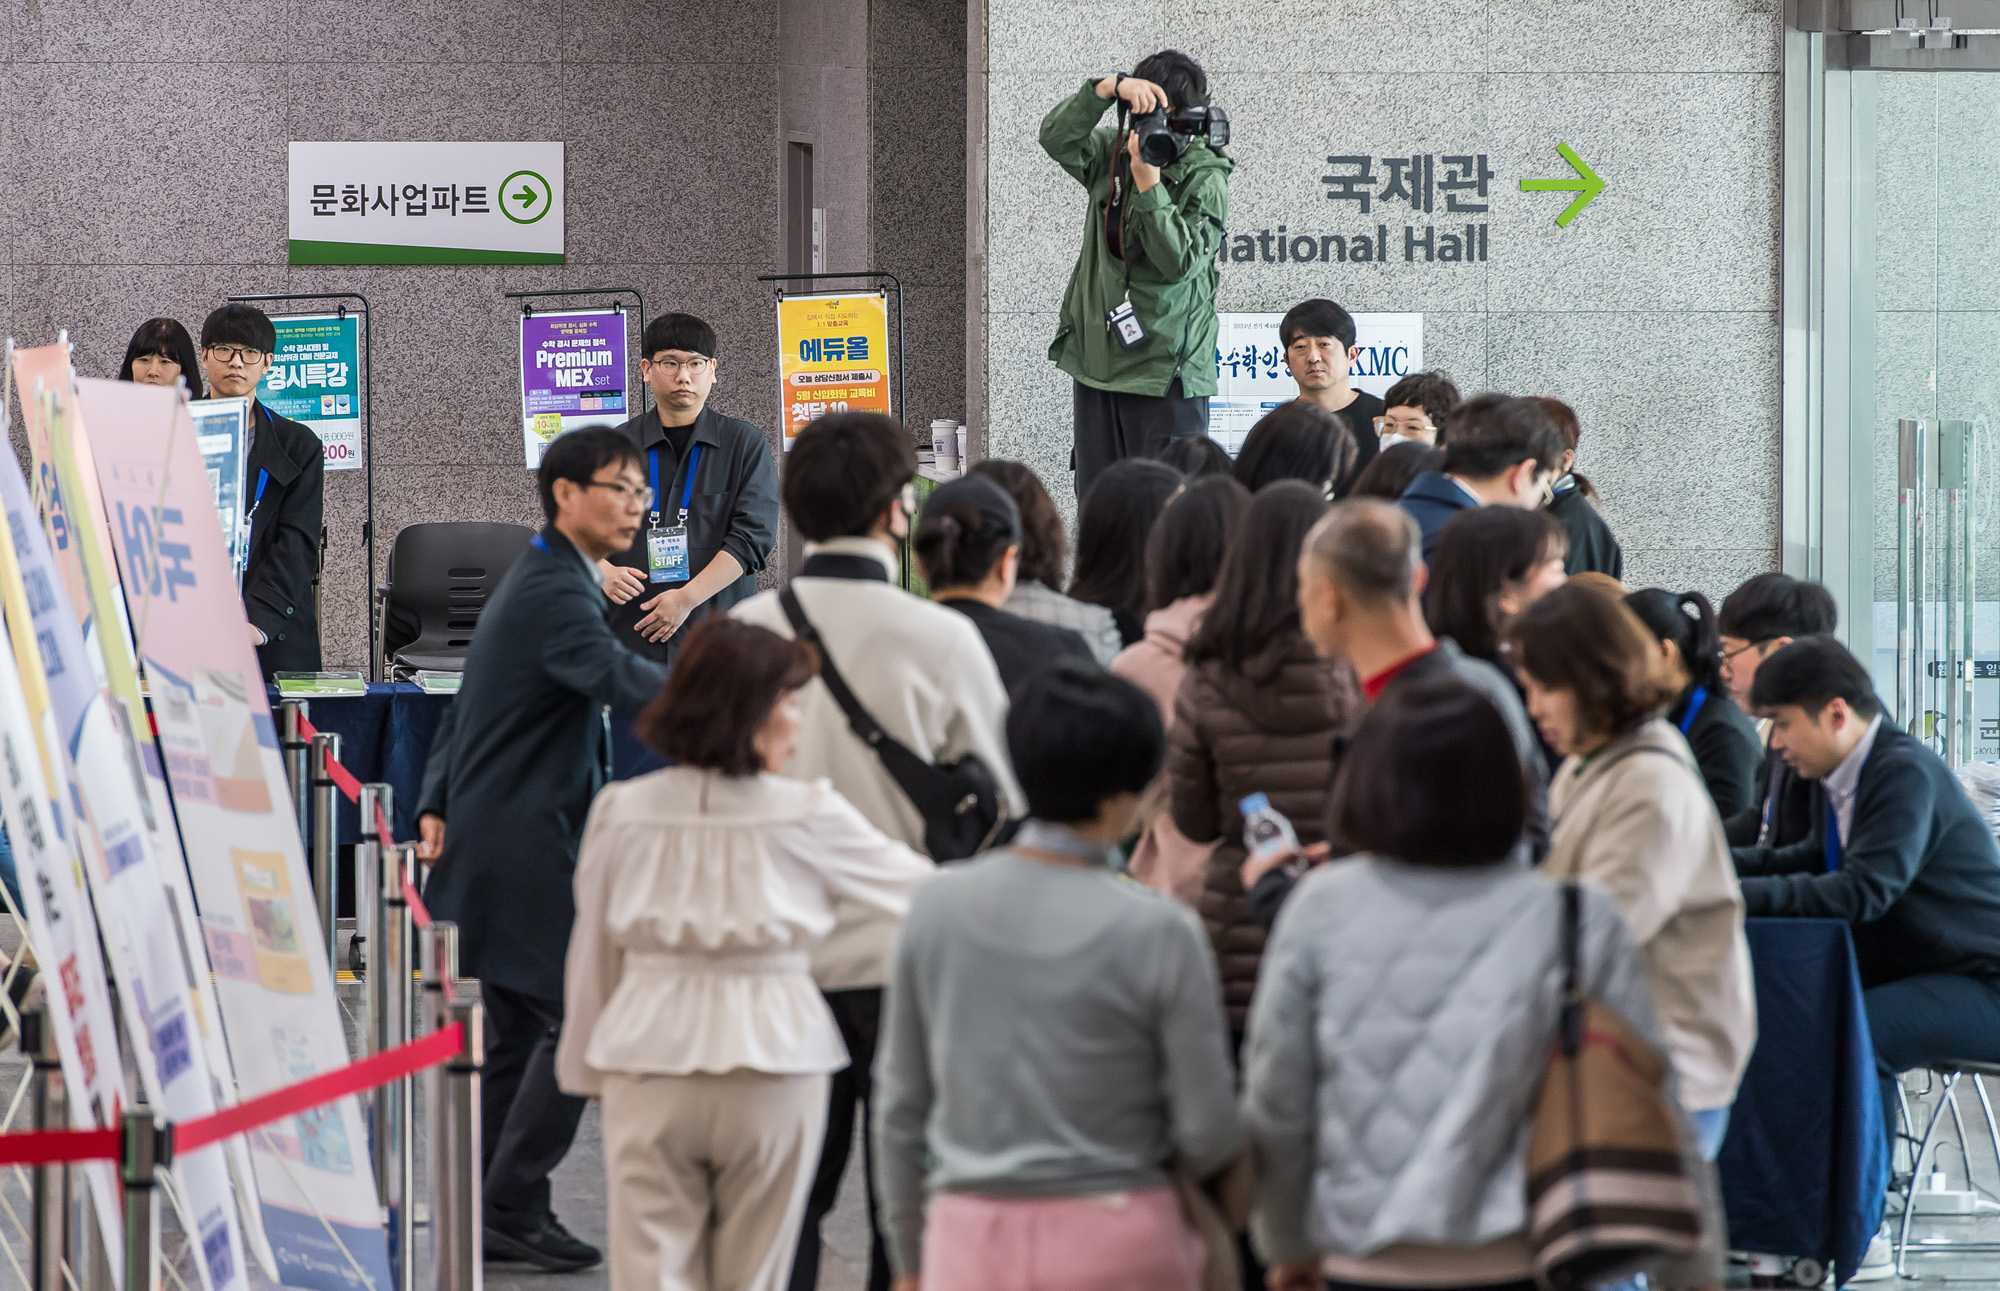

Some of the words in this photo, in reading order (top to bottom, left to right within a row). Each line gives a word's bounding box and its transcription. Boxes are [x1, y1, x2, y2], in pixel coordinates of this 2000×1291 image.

[1322, 154, 1495, 213] 국제관
[310, 184, 490, 216] 문화사업파트
[1219, 224, 1387, 263] ational
[1405, 223, 1488, 262] Hall
[282, 344, 296, 352] 수학
[296, 344, 322, 352] 경시대회
[571, 340, 592, 348] 문제의
[592, 338, 606, 346] 정석
[799, 336, 869, 362] 에듀올
[300, 352, 312, 360] 대비
[314, 352, 338, 360] 전문교재
[536, 349, 612, 368] Premium
[1215, 344, 1294, 379] 수학인
[266, 362, 348, 390] 경시특강
[556, 368, 594, 388] MEX
[594, 375, 610, 386] set
[798, 375, 812, 384] 오늘
[814, 373, 850, 382] 상담신청서
[851, 372, 872, 380] 제출시
[796, 390, 810, 400] 5월
[812, 389, 847, 400] 신입회원
[849, 388, 876, 398] 교육비
[792, 402, 827, 422] 첫달
[830, 401, 848, 414] 10
[323, 444, 354, 460] 200원
[654, 554, 684, 567] STAFF
